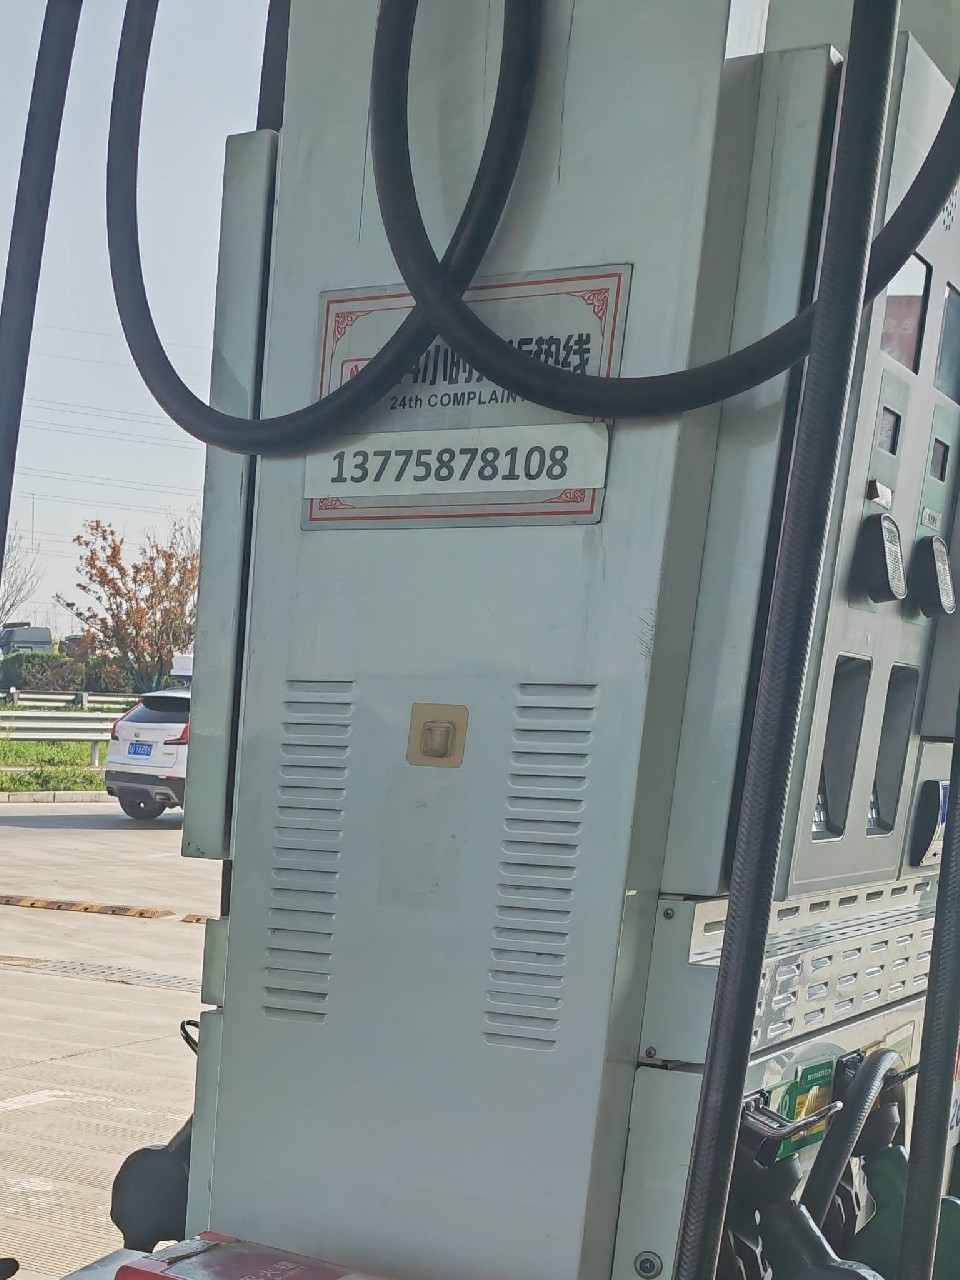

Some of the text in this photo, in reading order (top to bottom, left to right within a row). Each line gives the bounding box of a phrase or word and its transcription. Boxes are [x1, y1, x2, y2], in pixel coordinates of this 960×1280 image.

[389, 389, 526, 411] 24th COMPLAIN
[329, 445, 570, 484] 13775878108
